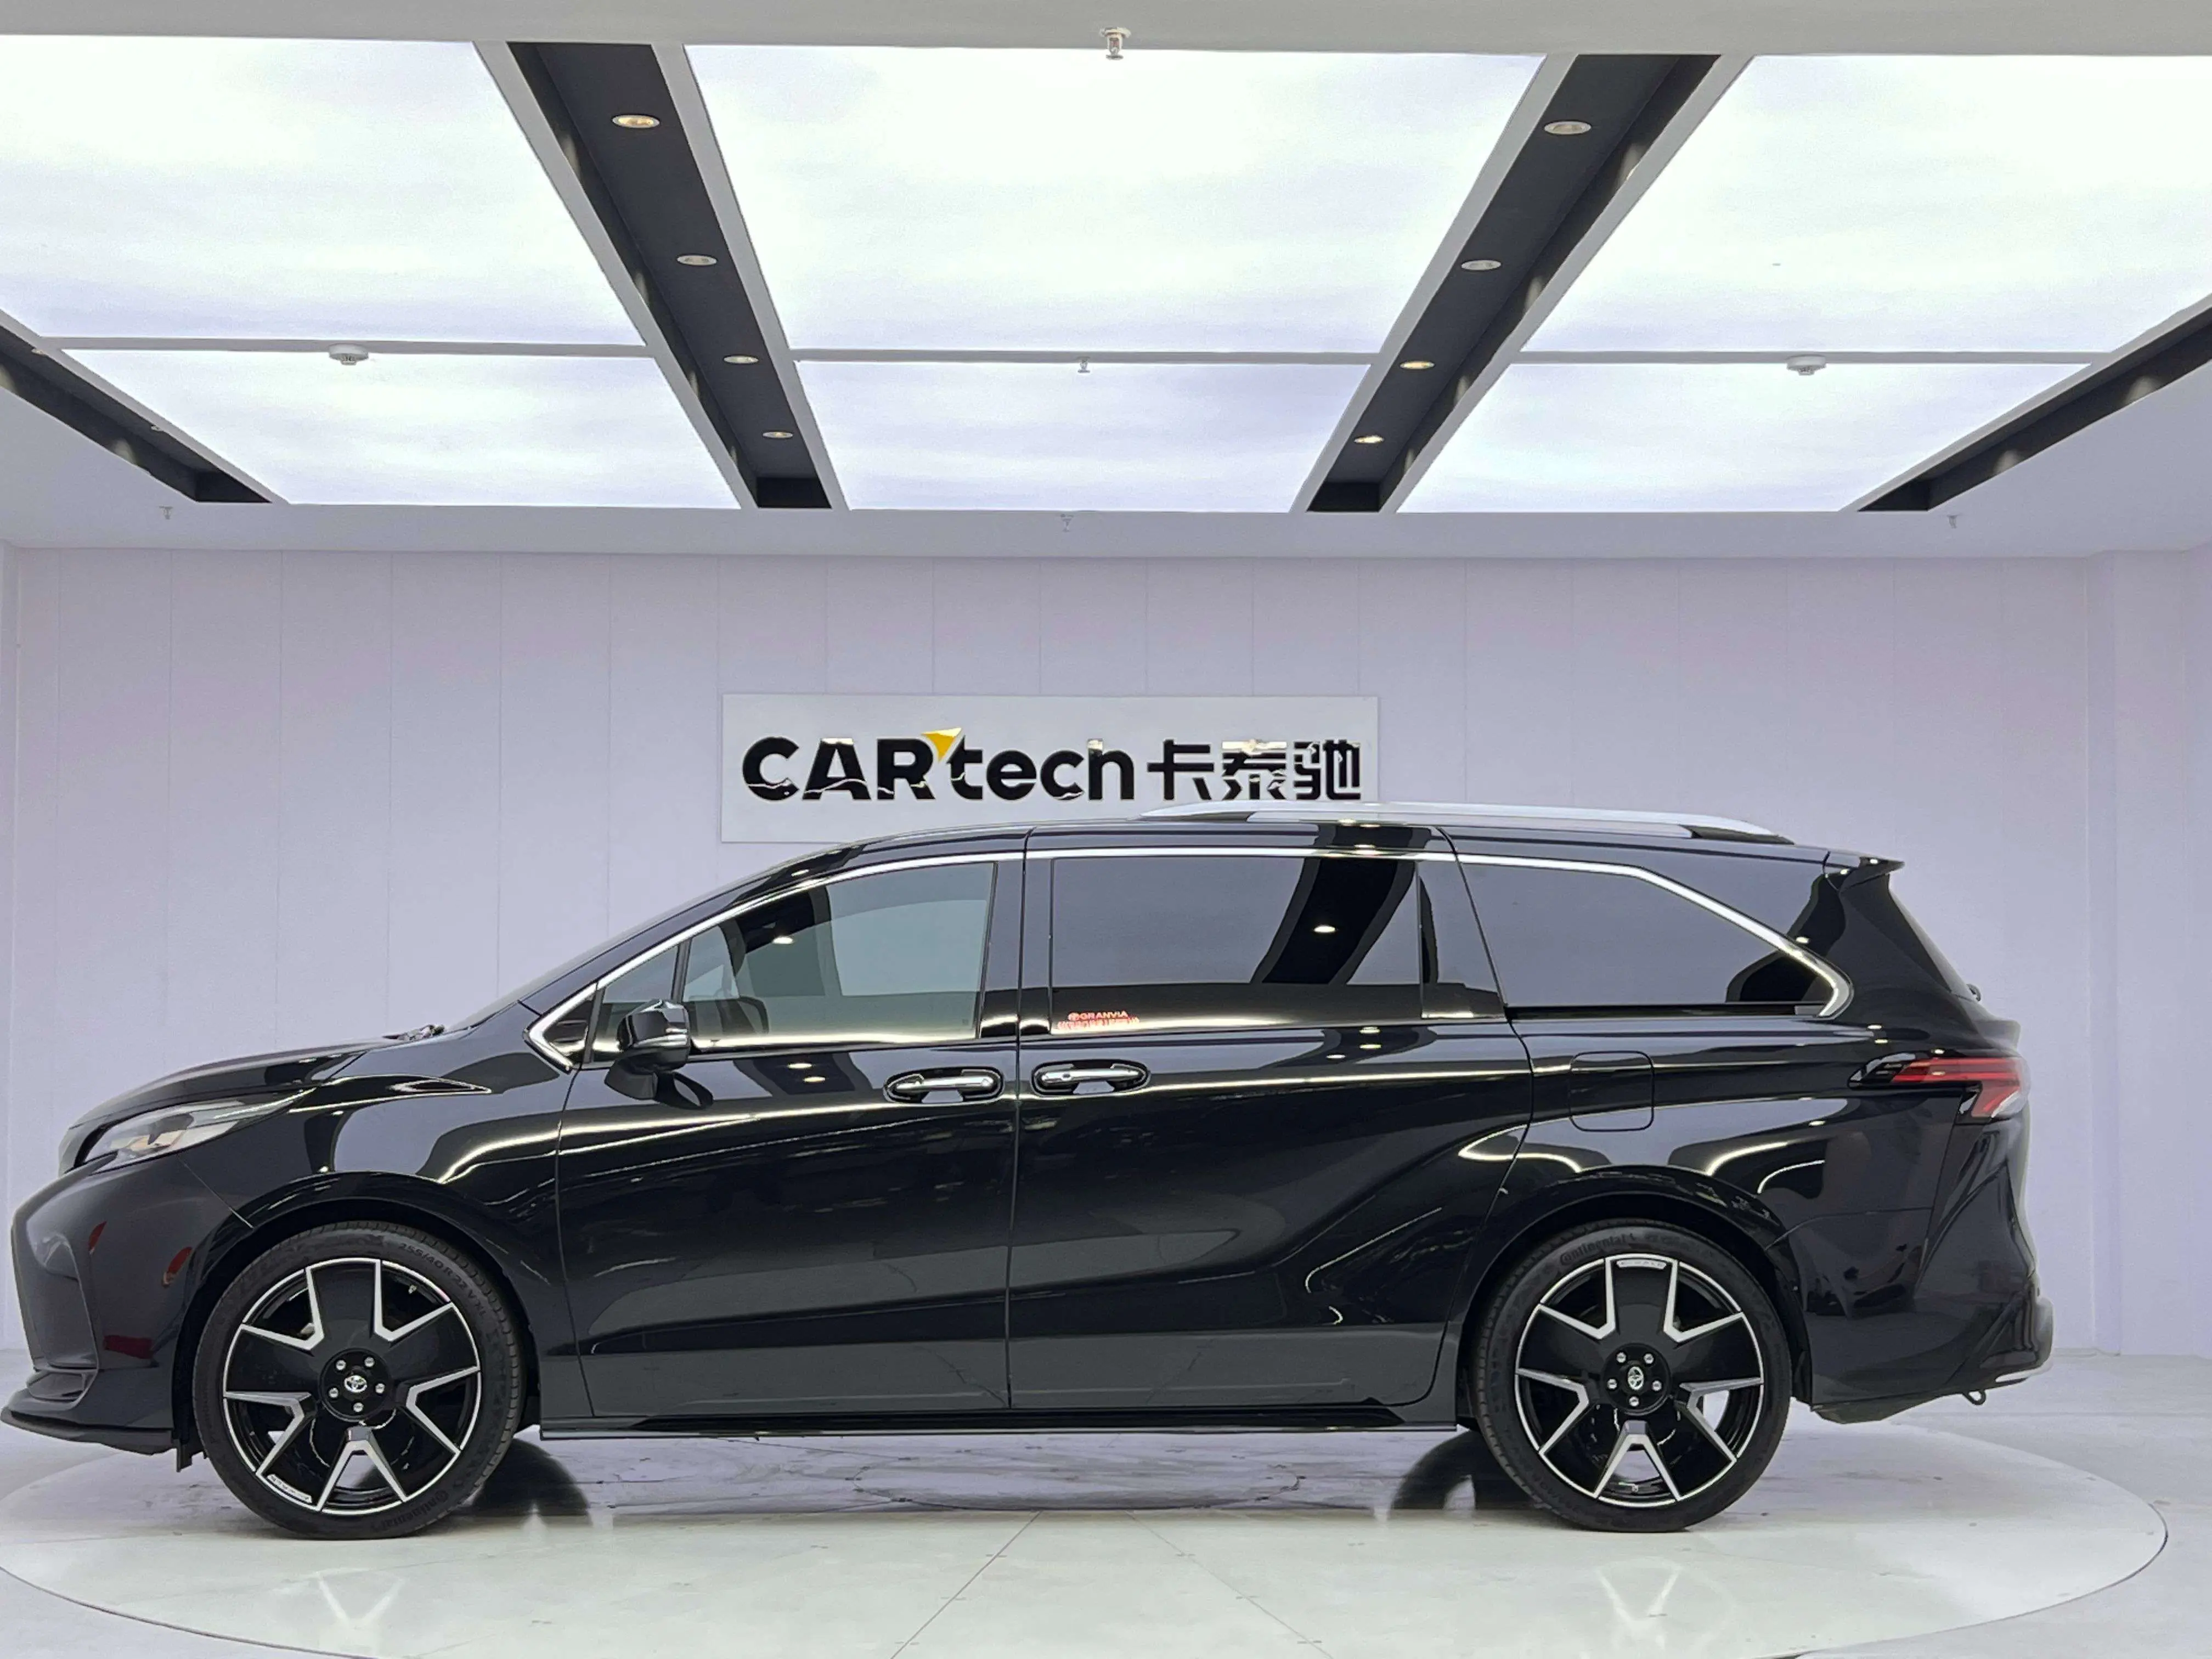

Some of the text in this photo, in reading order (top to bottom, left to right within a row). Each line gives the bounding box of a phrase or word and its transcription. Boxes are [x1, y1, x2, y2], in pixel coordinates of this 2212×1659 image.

[741, 735, 1362, 801] CARtech 卡泰驰
